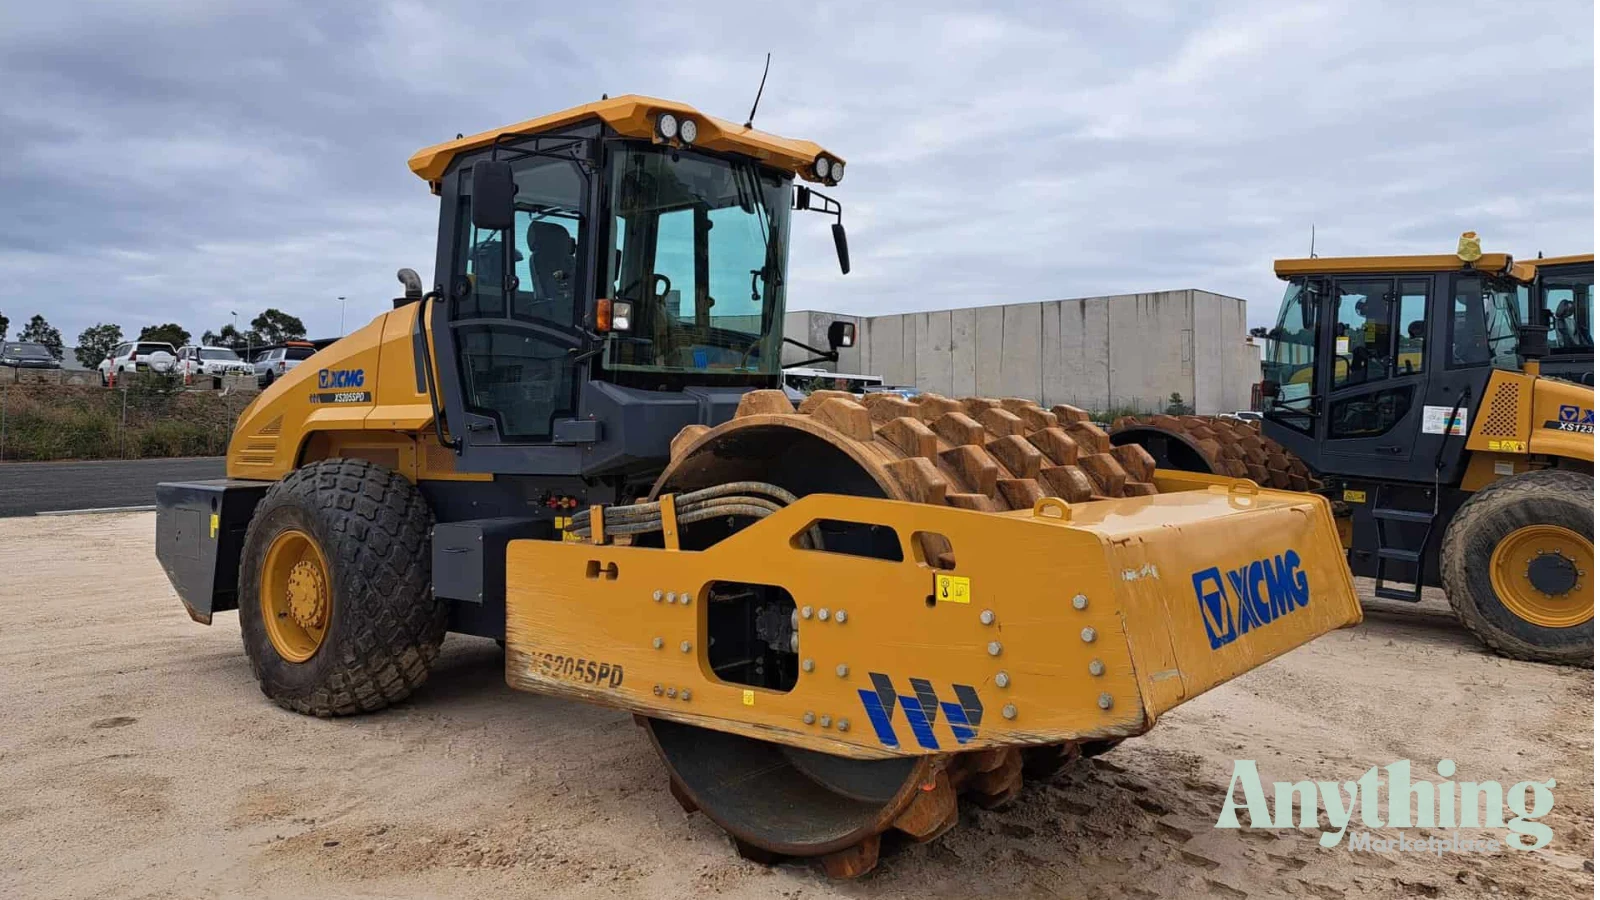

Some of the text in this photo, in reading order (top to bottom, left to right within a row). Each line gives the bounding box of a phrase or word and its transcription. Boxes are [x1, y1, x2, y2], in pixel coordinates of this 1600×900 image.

[328, 369, 364, 388] XCMG
[1559, 421, 1594, 433] XS123
[1226, 549, 1310, 636] XCMG
